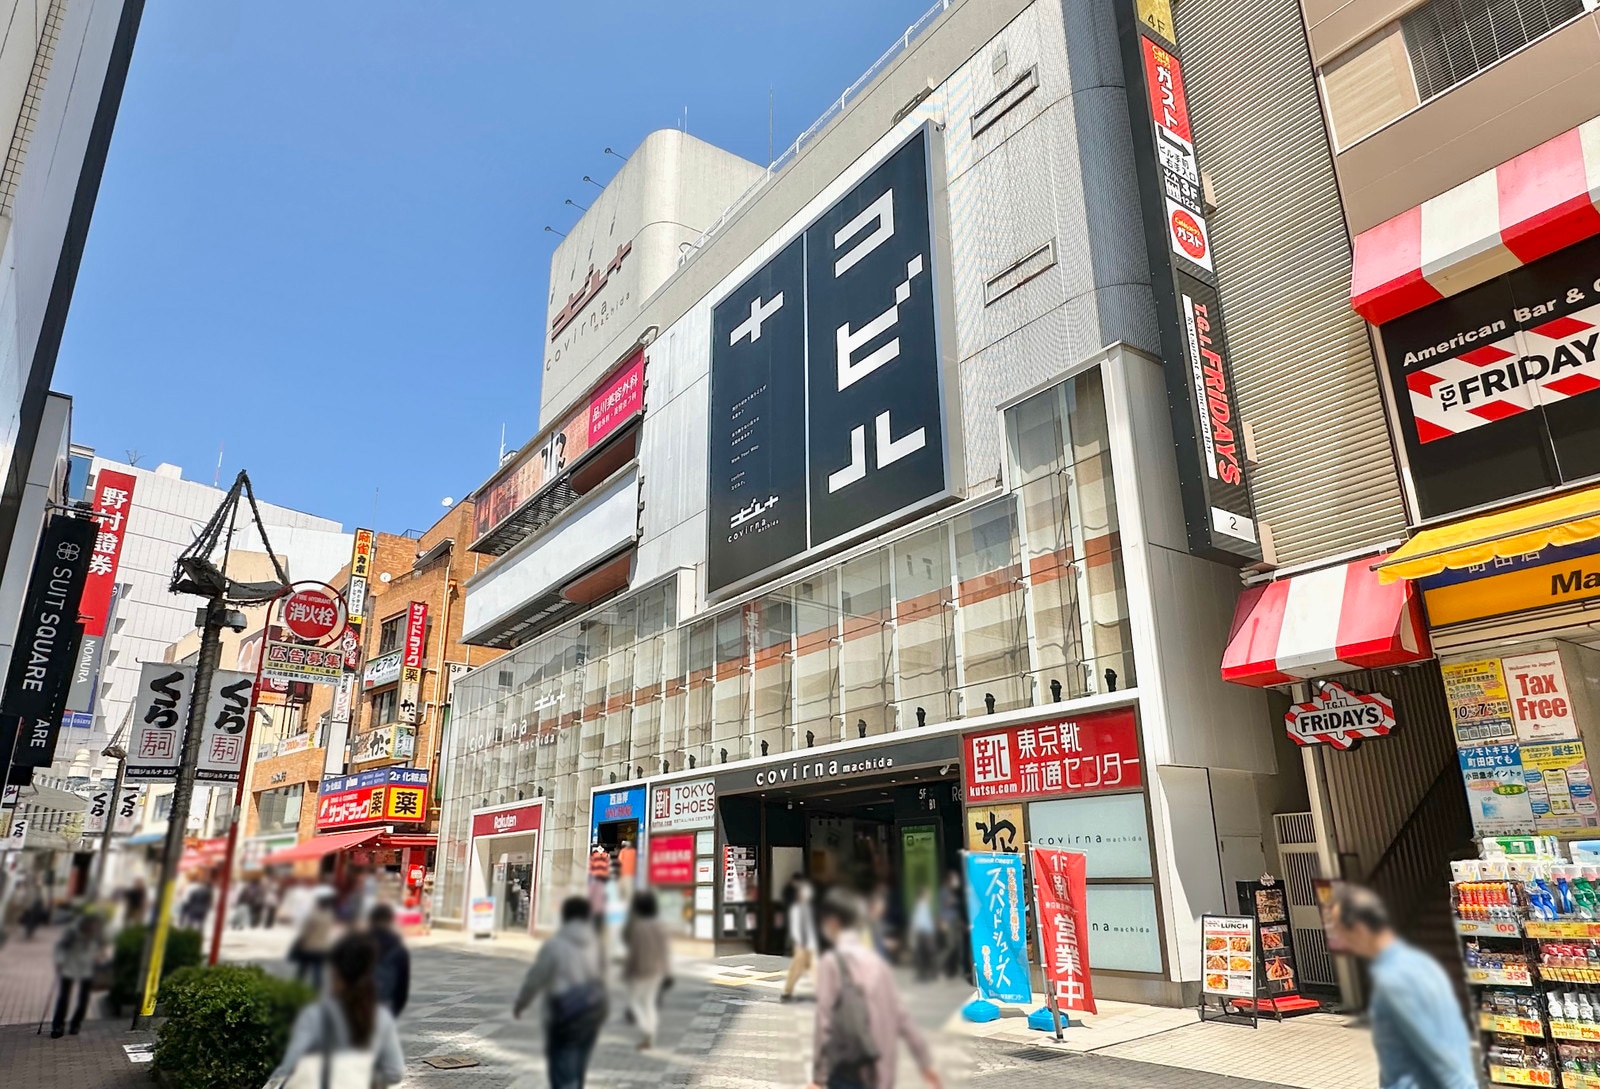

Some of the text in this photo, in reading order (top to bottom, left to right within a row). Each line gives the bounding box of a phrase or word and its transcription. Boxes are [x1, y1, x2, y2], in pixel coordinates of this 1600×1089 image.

[1147, 13, 1166, 33] 4F
[1157, 65, 1179, 128] ガスト
[1180, 178, 1198, 200] 3F
[1176, 226, 1203, 248] ガスト
[545, 300, 608, 372] covirna
[1402, 287, 1586, 368] American Bar &
[828, 187, 924, 494] コビル
[591, 371, 639, 423] 品川美容外科
[1438, 383, 1459, 412] TGI
[87, 486, 129, 576] 野村證券
[727, 518, 766, 543] covirna
[1228, 516, 1239, 532] 2
[45, 566, 73, 611] SUIT
[288, 602, 335, 627] 消火栓
[405, 603, 425, 667] サンドラッグ
[22, 612, 61, 693] SQUARE
[77, 639, 97, 685] NOMURA
[269, 645, 341, 669] 広告募集
[405, 668, 419, 682] 薬
[450, 664, 463, 674] 3F
[1515, 673, 1559, 696] Tax
[144, 671, 185, 729] くら
[215, 678, 253, 735] くら
[1325, 701, 1346, 710] T.G.I.
[1515, 697, 1568, 721] Free
[140, 730, 175, 759] 寿司
[469, 718, 528, 752] covirna
[1016, 720, 1083, 761] 東京靴
[210, 735, 243, 763] 寿司
[974, 738, 1010, 782] 靴
[1459, 744, 1518, 757] マツモトキヨシ
[1466, 754, 1513, 768] 町田店でも
[389, 771, 401, 781] 2F
[402, 771, 428, 782] 化粧品
[755, 756, 894, 787] covirna machida
[1018, 751, 1141, 795] 流通センター
[674, 782, 716, 800] TOKYO
[968, 782, 1018, 798] kutsu.com
[90, 792, 108, 817] くら
[120, 793, 138, 817] くら
[328, 799, 371, 823] サンドラッグ
[370, 791, 384, 815] 薬
[394, 791, 418, 815] 薬
[674, 798, 715, 815] SHOES
[12, 821, 26, 838] くら
[493, 813, 517, 830] Rakuten
[1037, 832, 1143, 846] covirna machida
[1050, 854, 1068, 873] 1F
[1113, 925, 1151, 934] machida
[1496, 923, 1516, 933] 100
[1053, 911, 1085, 1008] 営業中
[1506, 971, 1528, 981] 358
